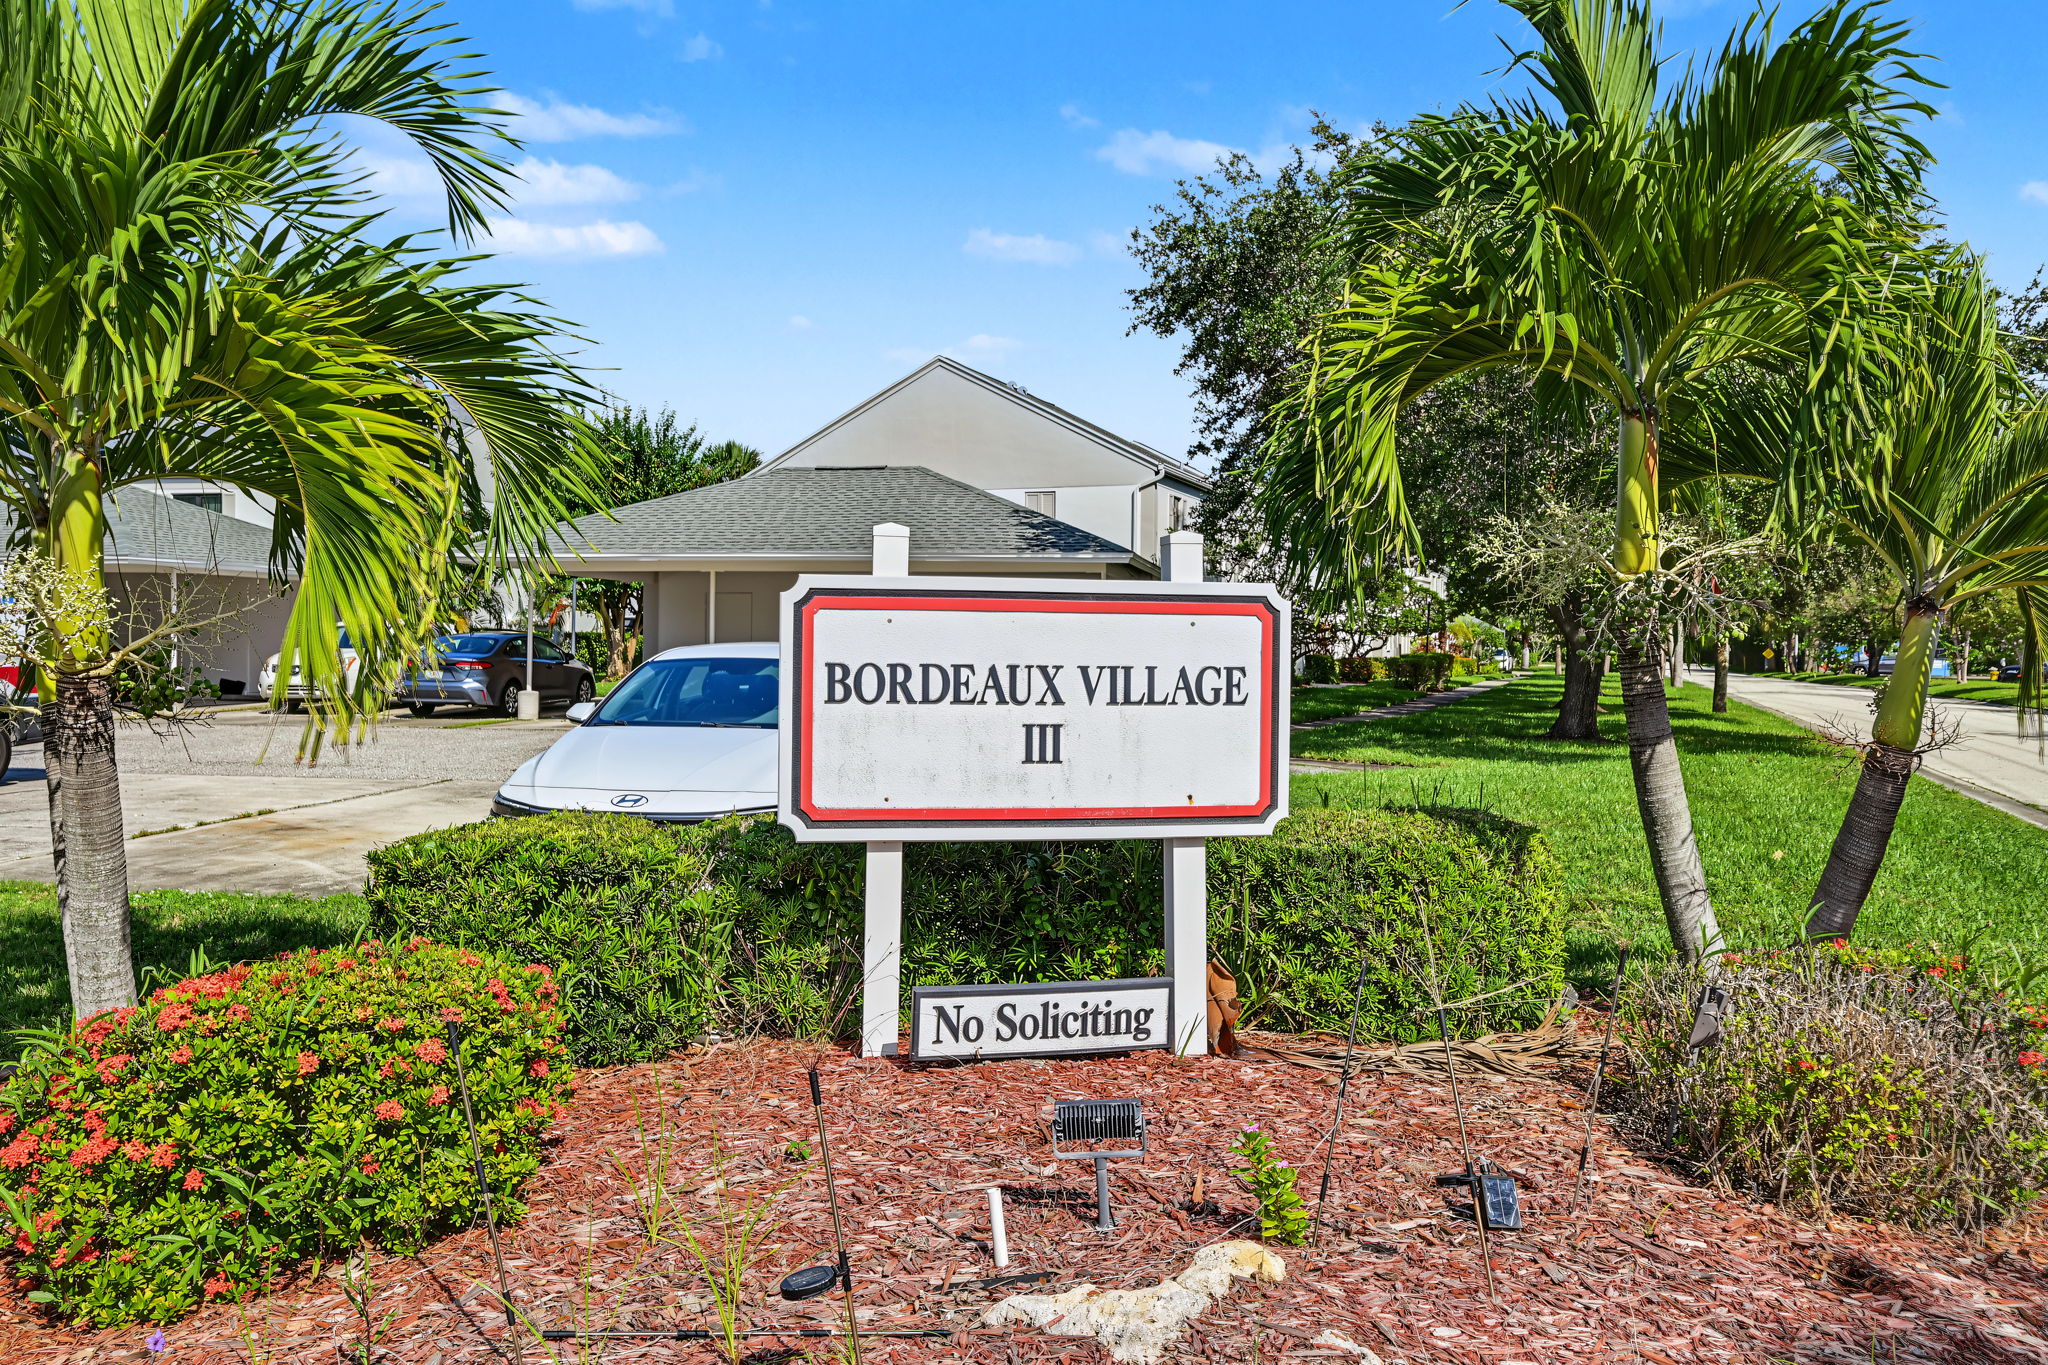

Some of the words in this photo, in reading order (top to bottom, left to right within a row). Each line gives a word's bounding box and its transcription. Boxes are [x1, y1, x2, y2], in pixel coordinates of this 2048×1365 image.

[824, 662, 1066, 706] BORDEAUX
[1076, 665, 1249, 706] VILLAGE
[1021, 723, 1064, 765] III
[931, 1004, 984, 1045] No
[995, 1000, 1155, 1042] Soliciting
